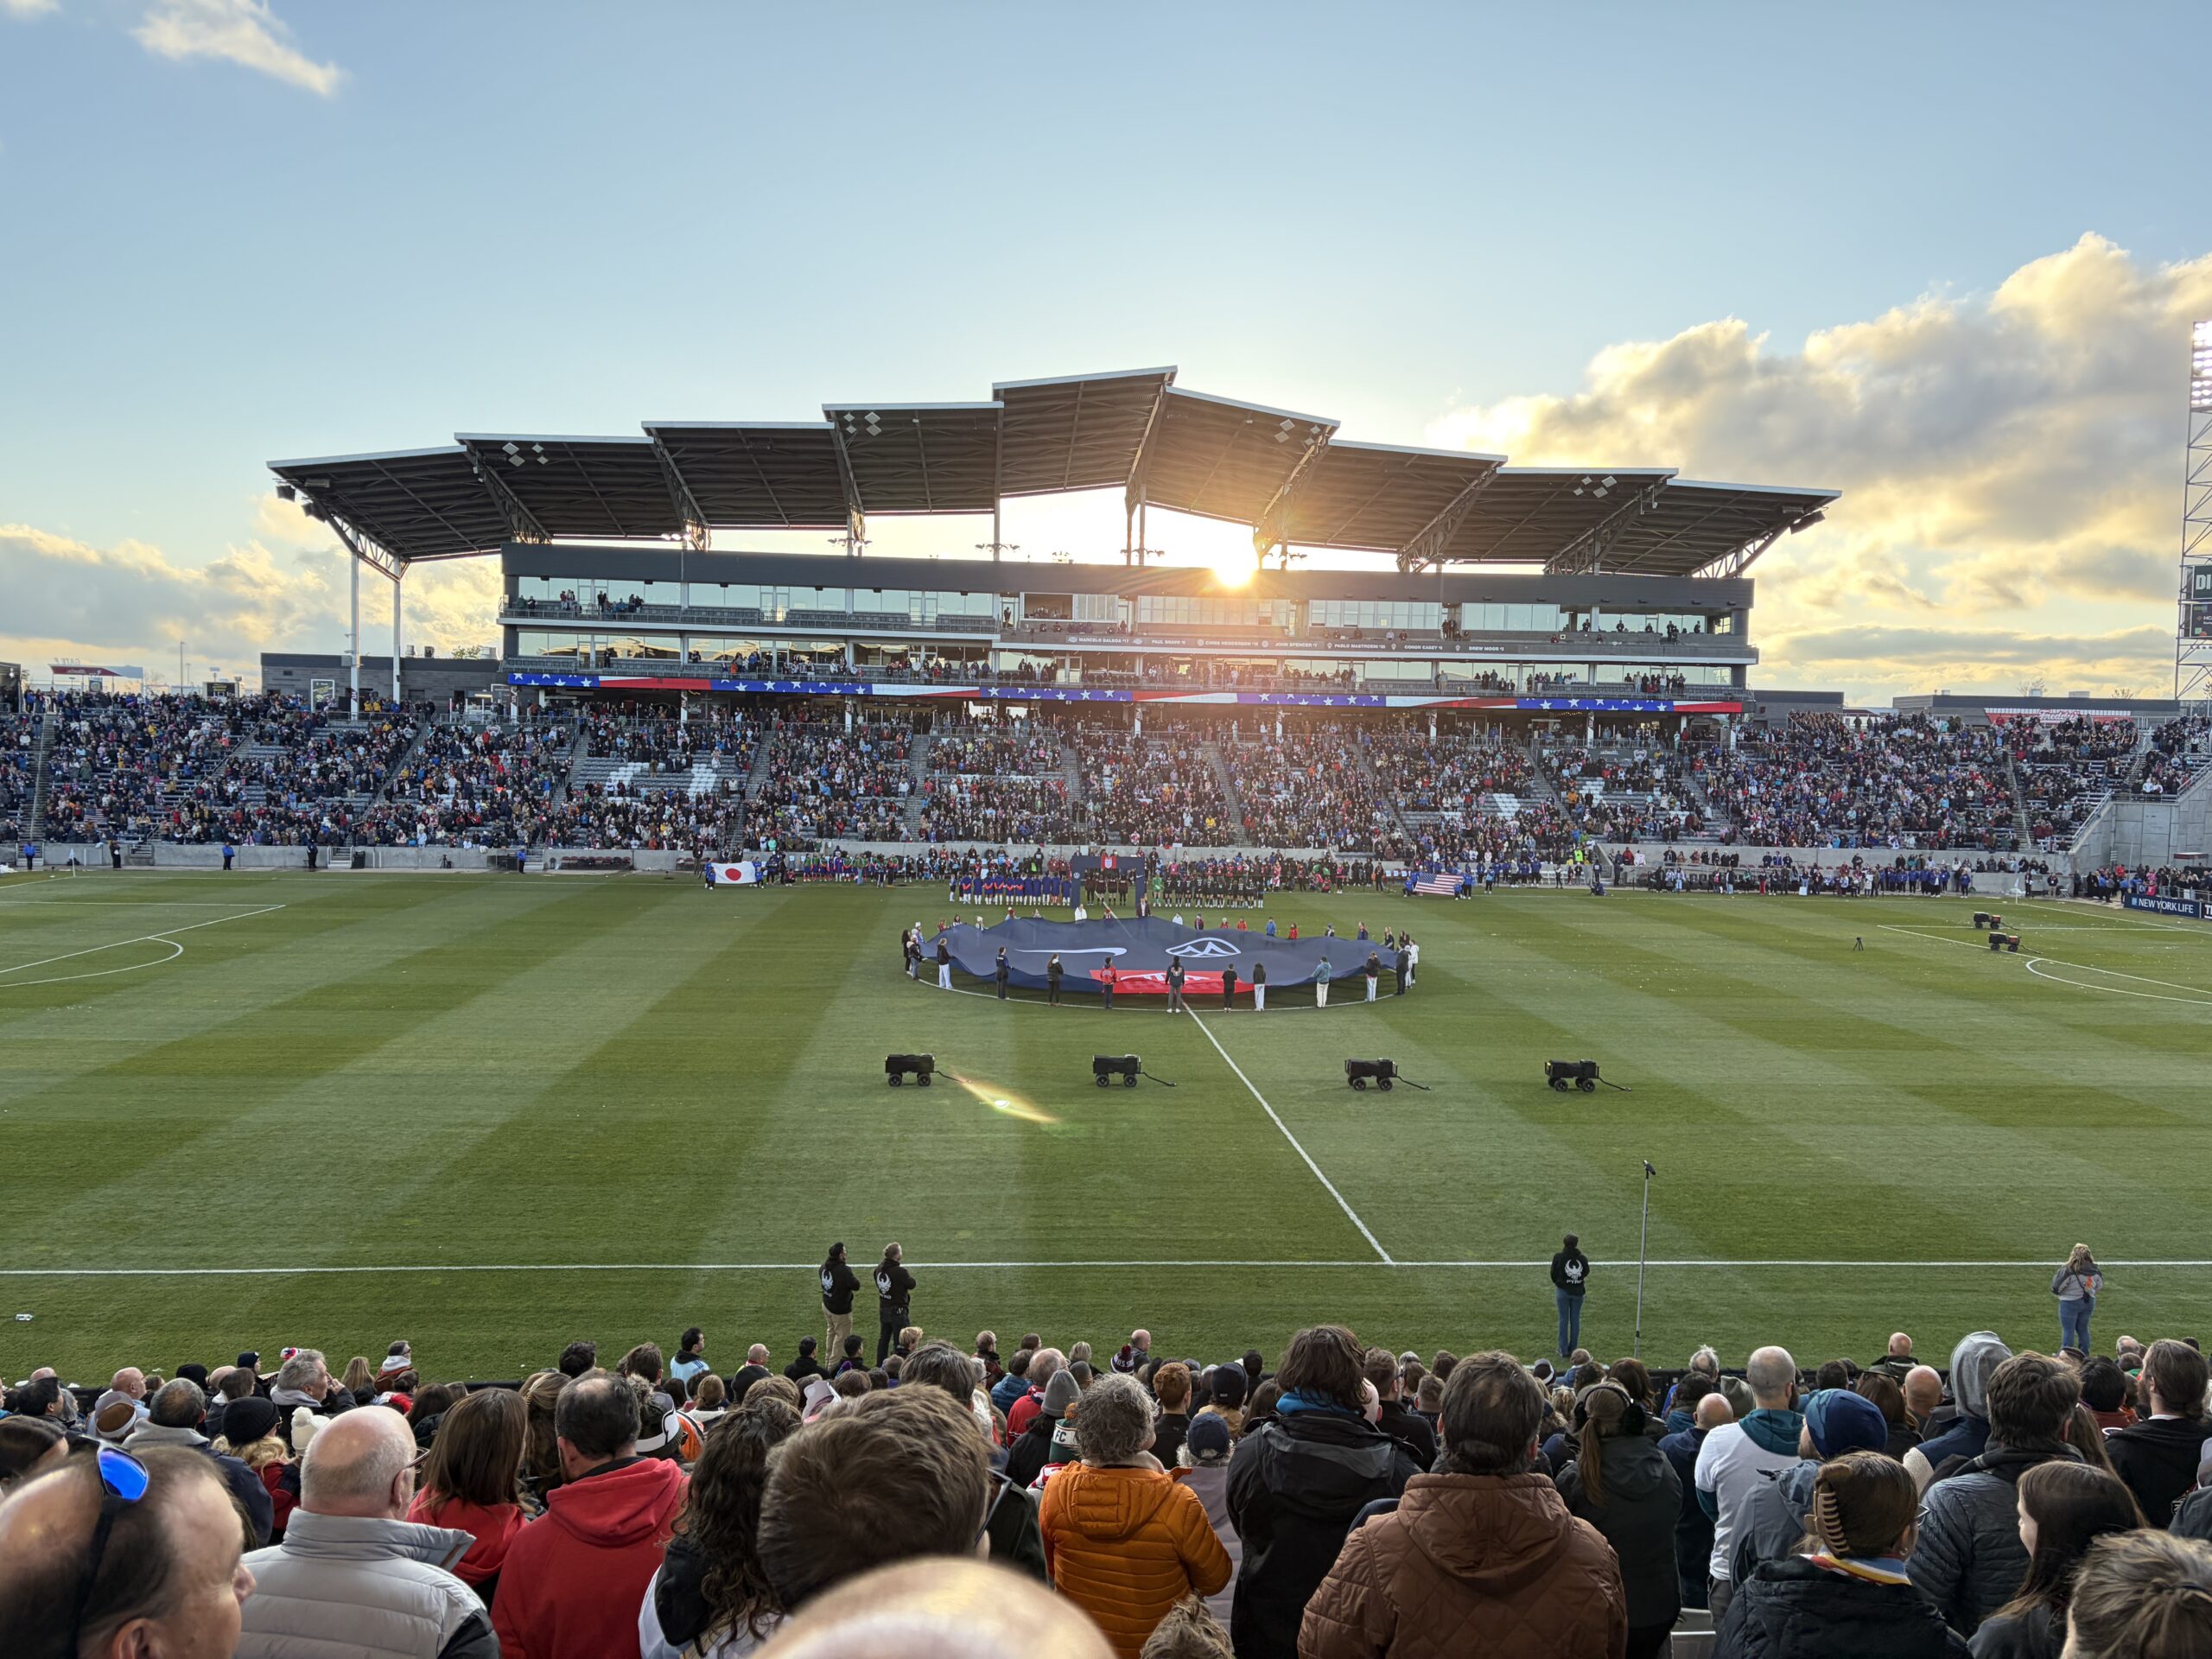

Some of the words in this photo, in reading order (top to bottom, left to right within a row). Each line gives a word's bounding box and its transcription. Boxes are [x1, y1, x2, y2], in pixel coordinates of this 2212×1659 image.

[2139, 898, 2157, 908] NEW
[2156, 900, 2177, 912] YORK
[2177, 903, 2194, 914] LIFE
[1055, 1429, 1067, 1442] FC
